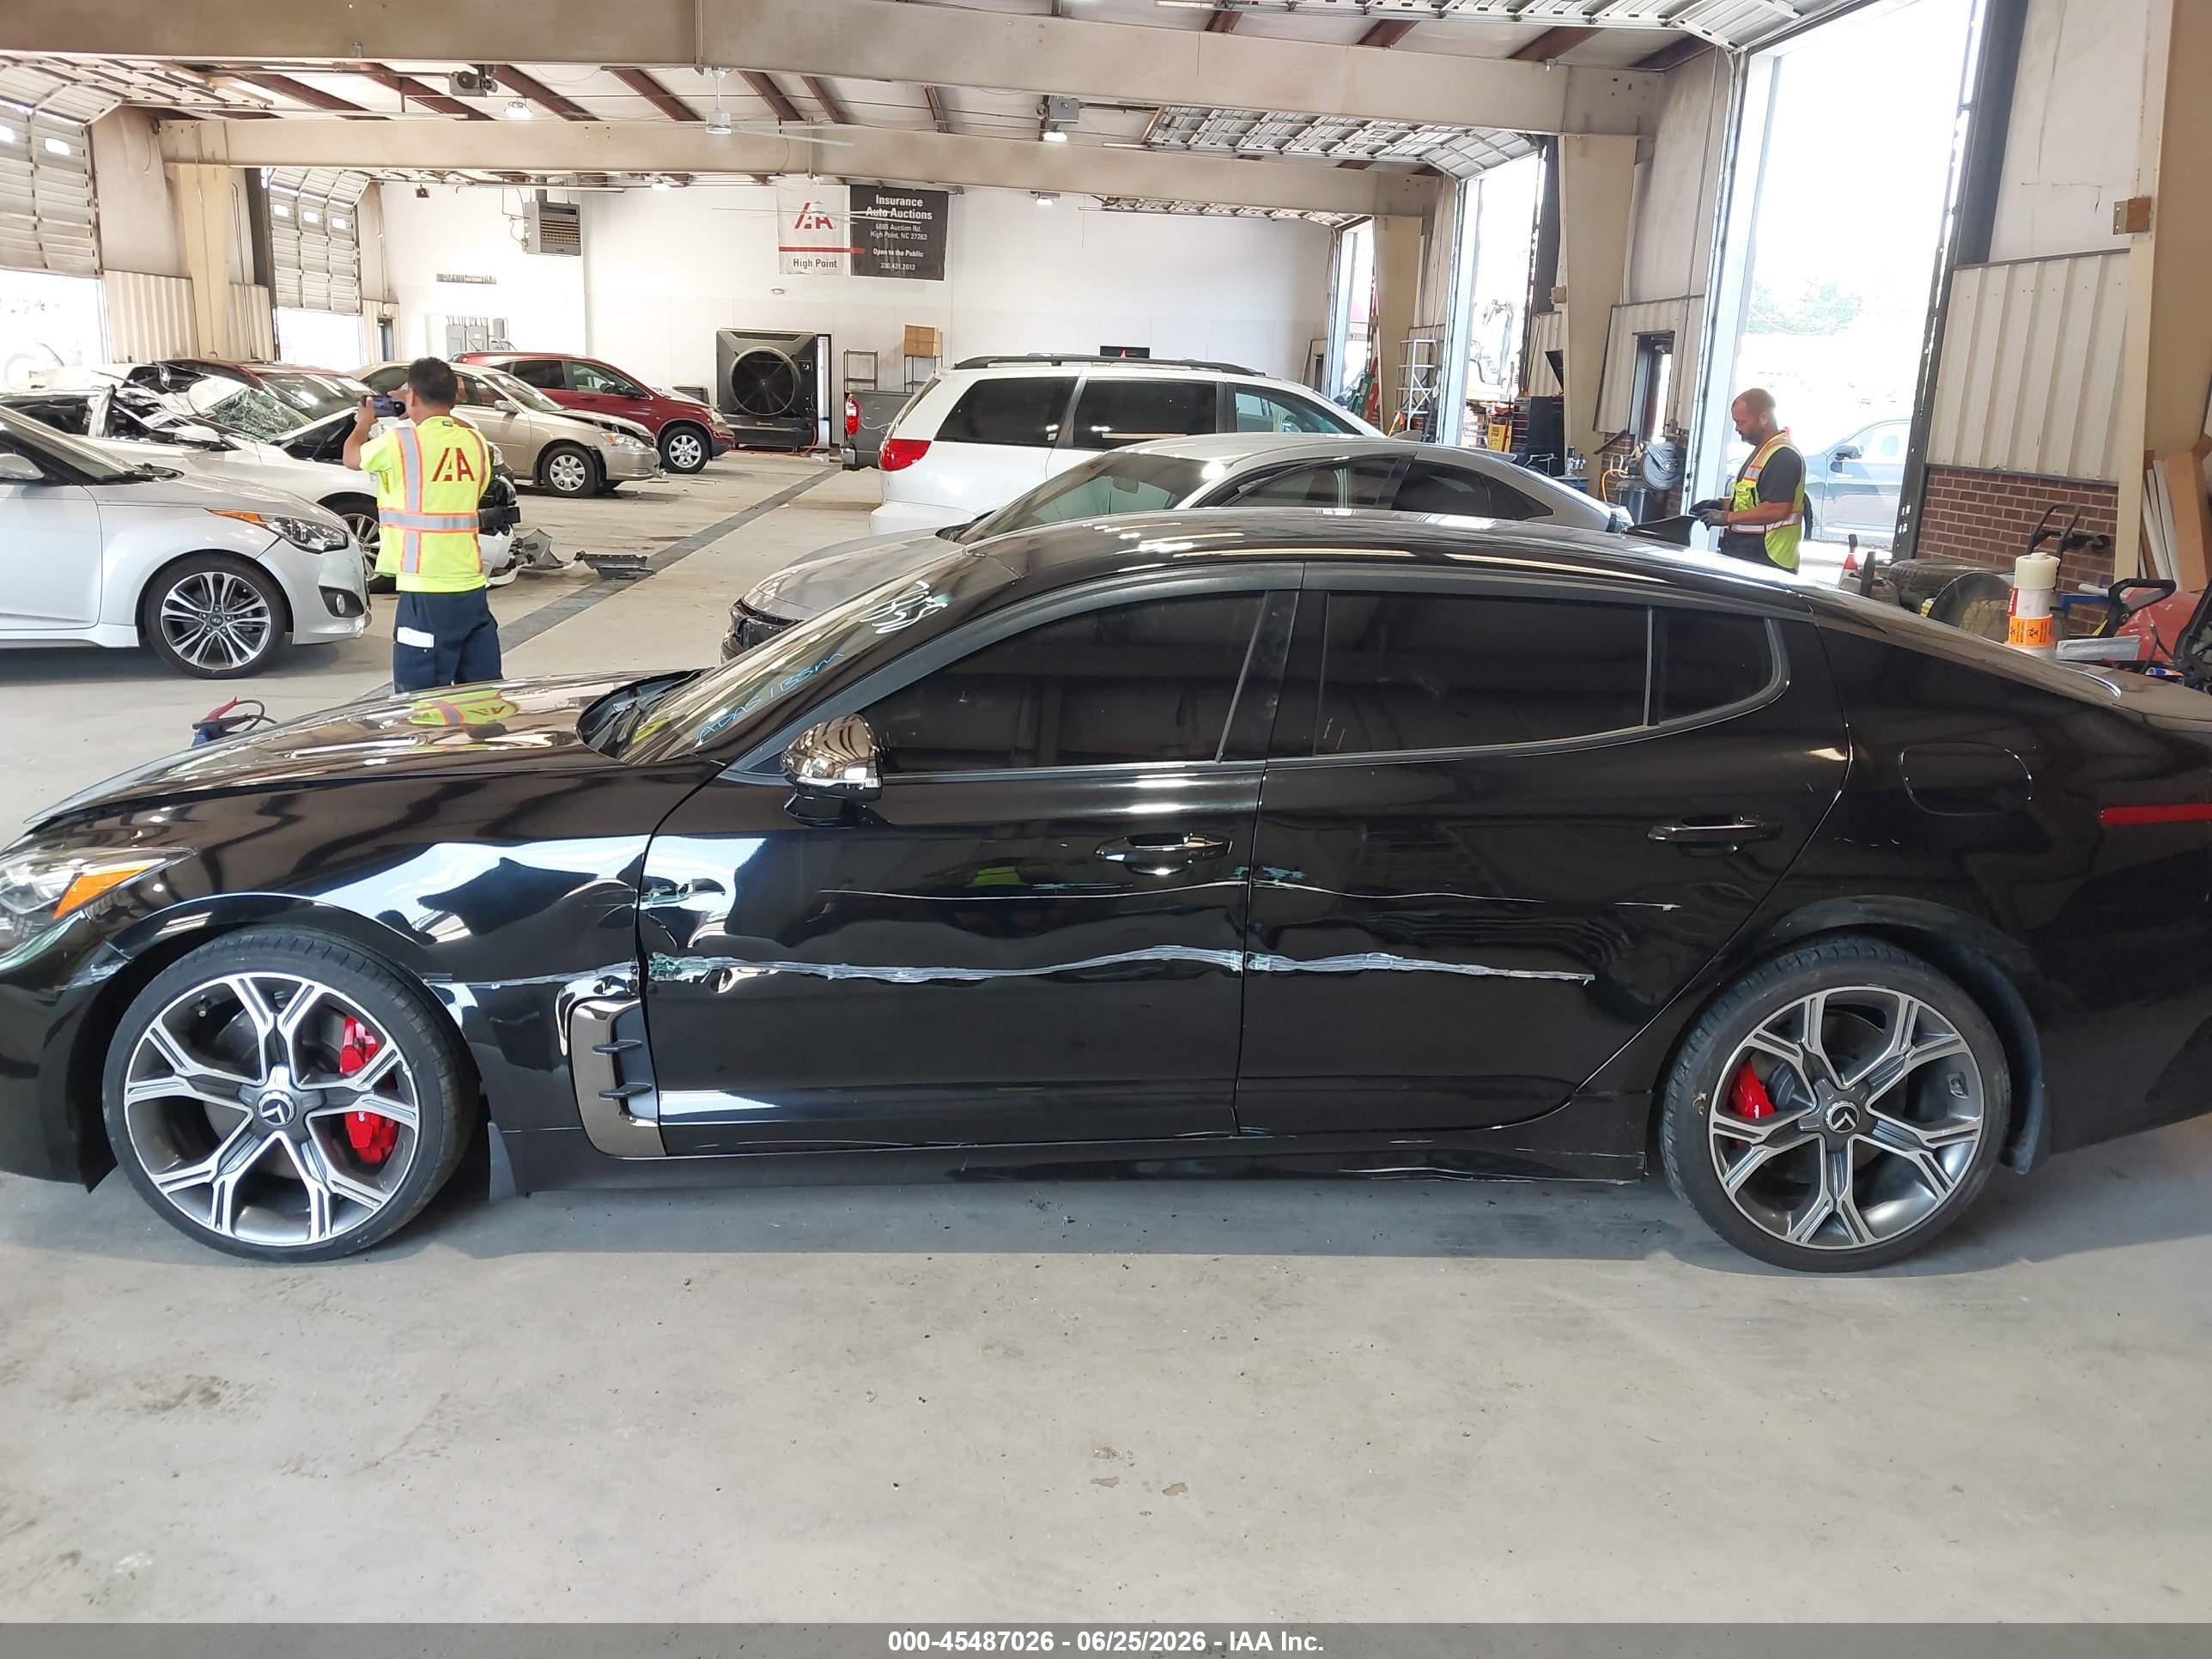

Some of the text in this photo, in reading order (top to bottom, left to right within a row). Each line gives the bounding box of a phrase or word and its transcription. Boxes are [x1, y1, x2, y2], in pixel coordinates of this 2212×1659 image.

[875, 193, 924, 207] Insurance
[865, 205, 933, 221] Auto Auctions
[890, 223, 912, 232] Auction
[870, 230, 884, 239] High
[872, 247, 888, 257] Open
[905, 249, 924, 258] Public
[793, 258, 838, 269] High Point
